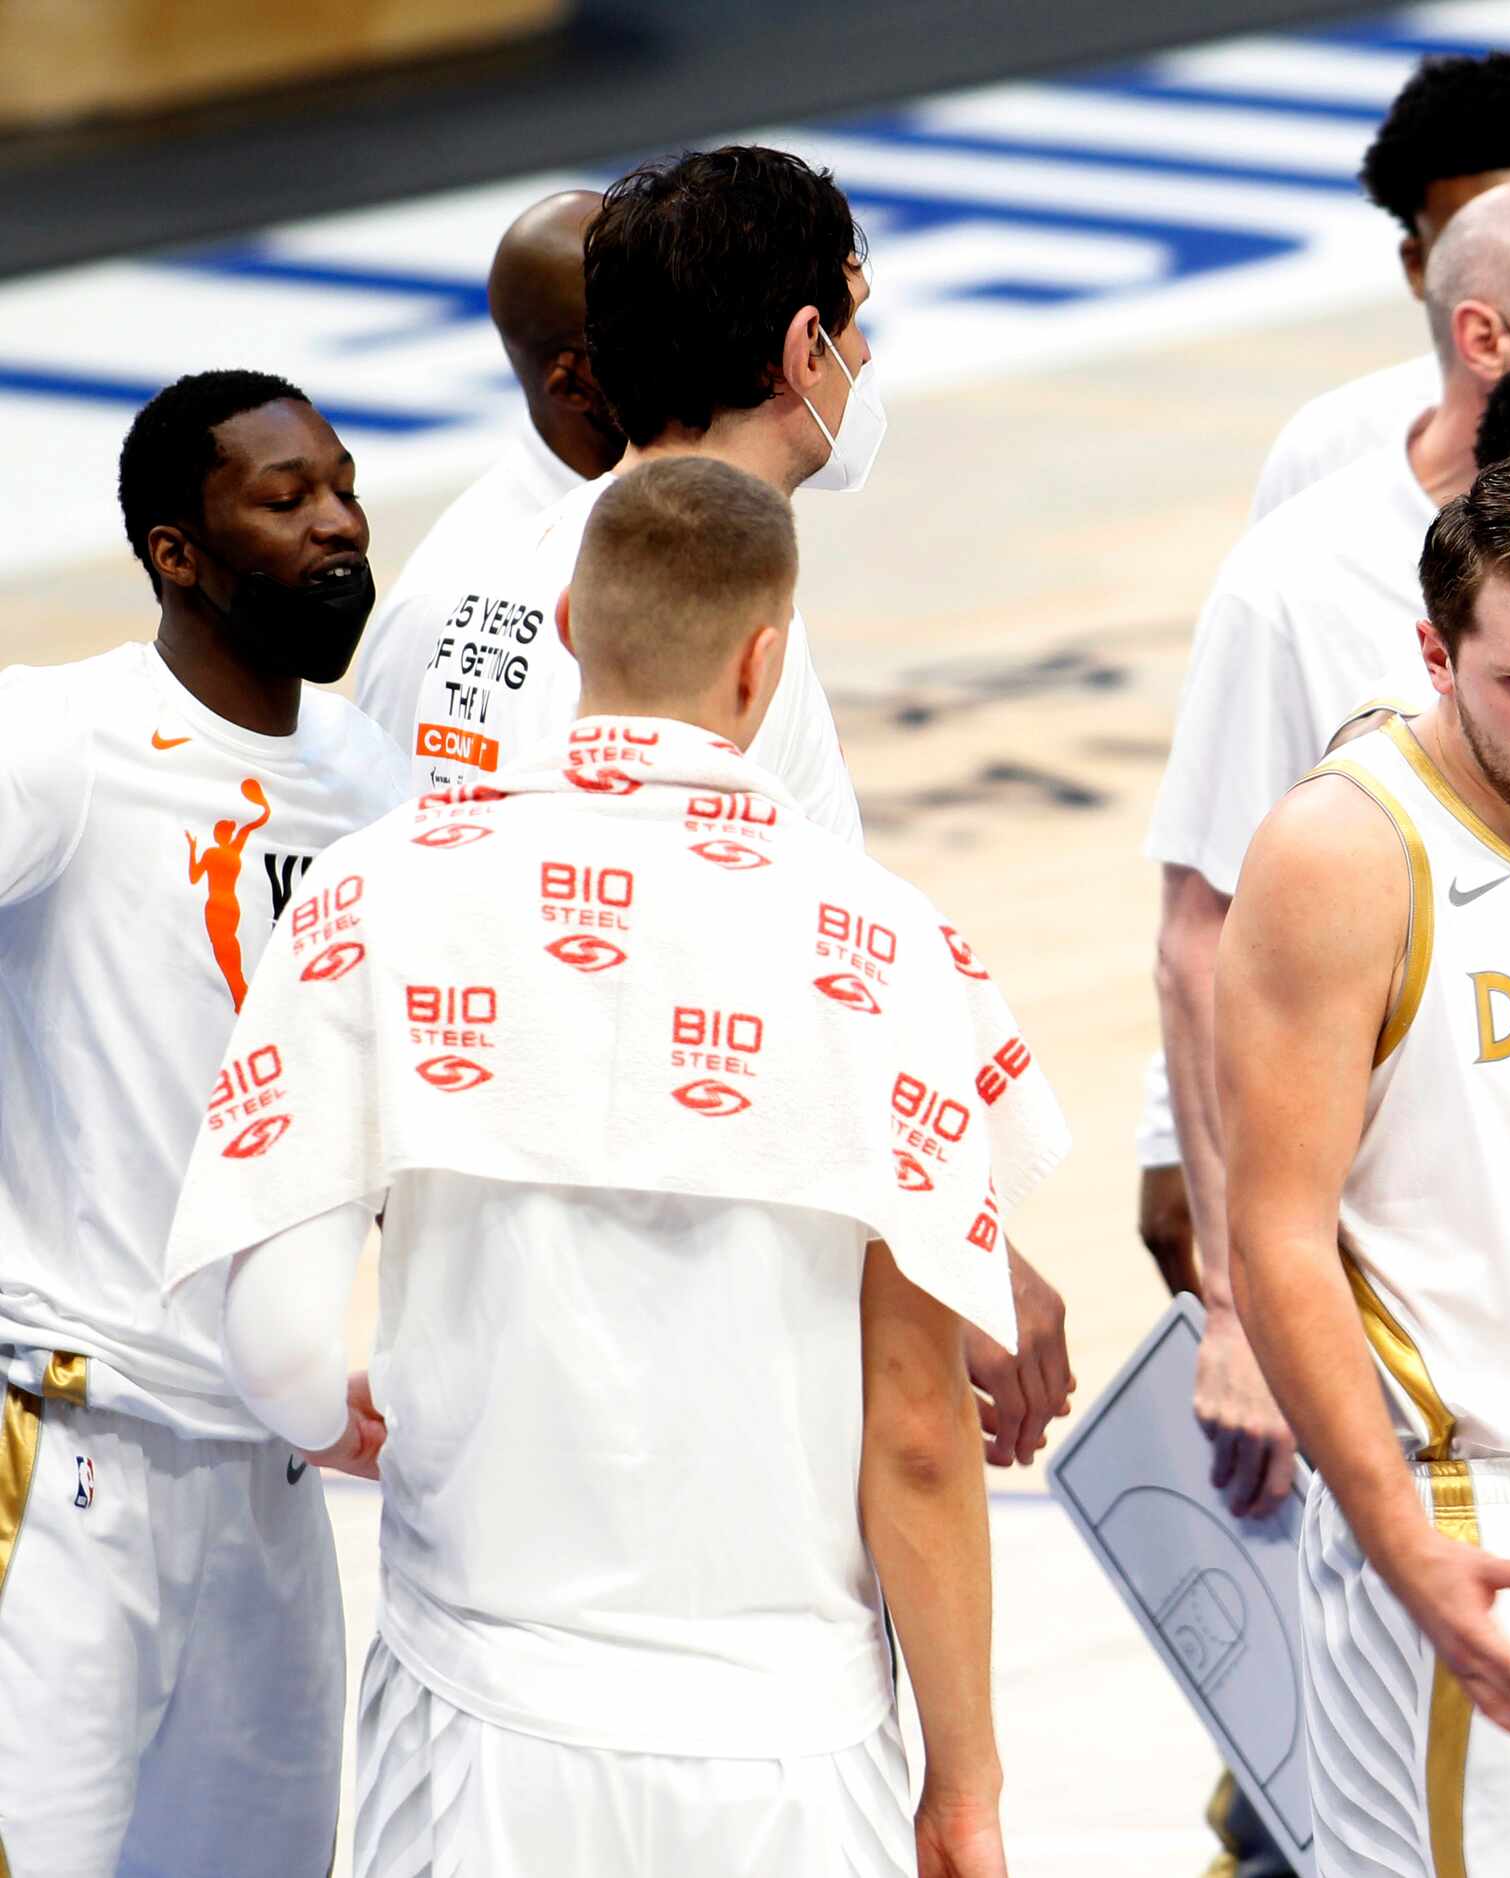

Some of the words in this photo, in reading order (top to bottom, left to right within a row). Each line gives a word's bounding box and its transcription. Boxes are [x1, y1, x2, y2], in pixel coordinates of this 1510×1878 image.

[569, 747, 654, 766] STEEL
[292, 874, 364, 937] BIO
[541, 861, 633, 908] BIO
[541, 904, 629, 931] STEEL
[818, 902, 897, 965] BIO
[816, 940, 889, 986] STEEL
[405, 985, 497, 1025] BIO
[409, 1027, 495, 1048] STEEL
[672, 1006, 762, 1054] BIO
[671, 1050, 757, 1077] STEEL
[208, 1088, 288, 1131] STEEL
[892, 1072, 970, 1142] BIO
[891, 1113, 947, 1164] TEEL
